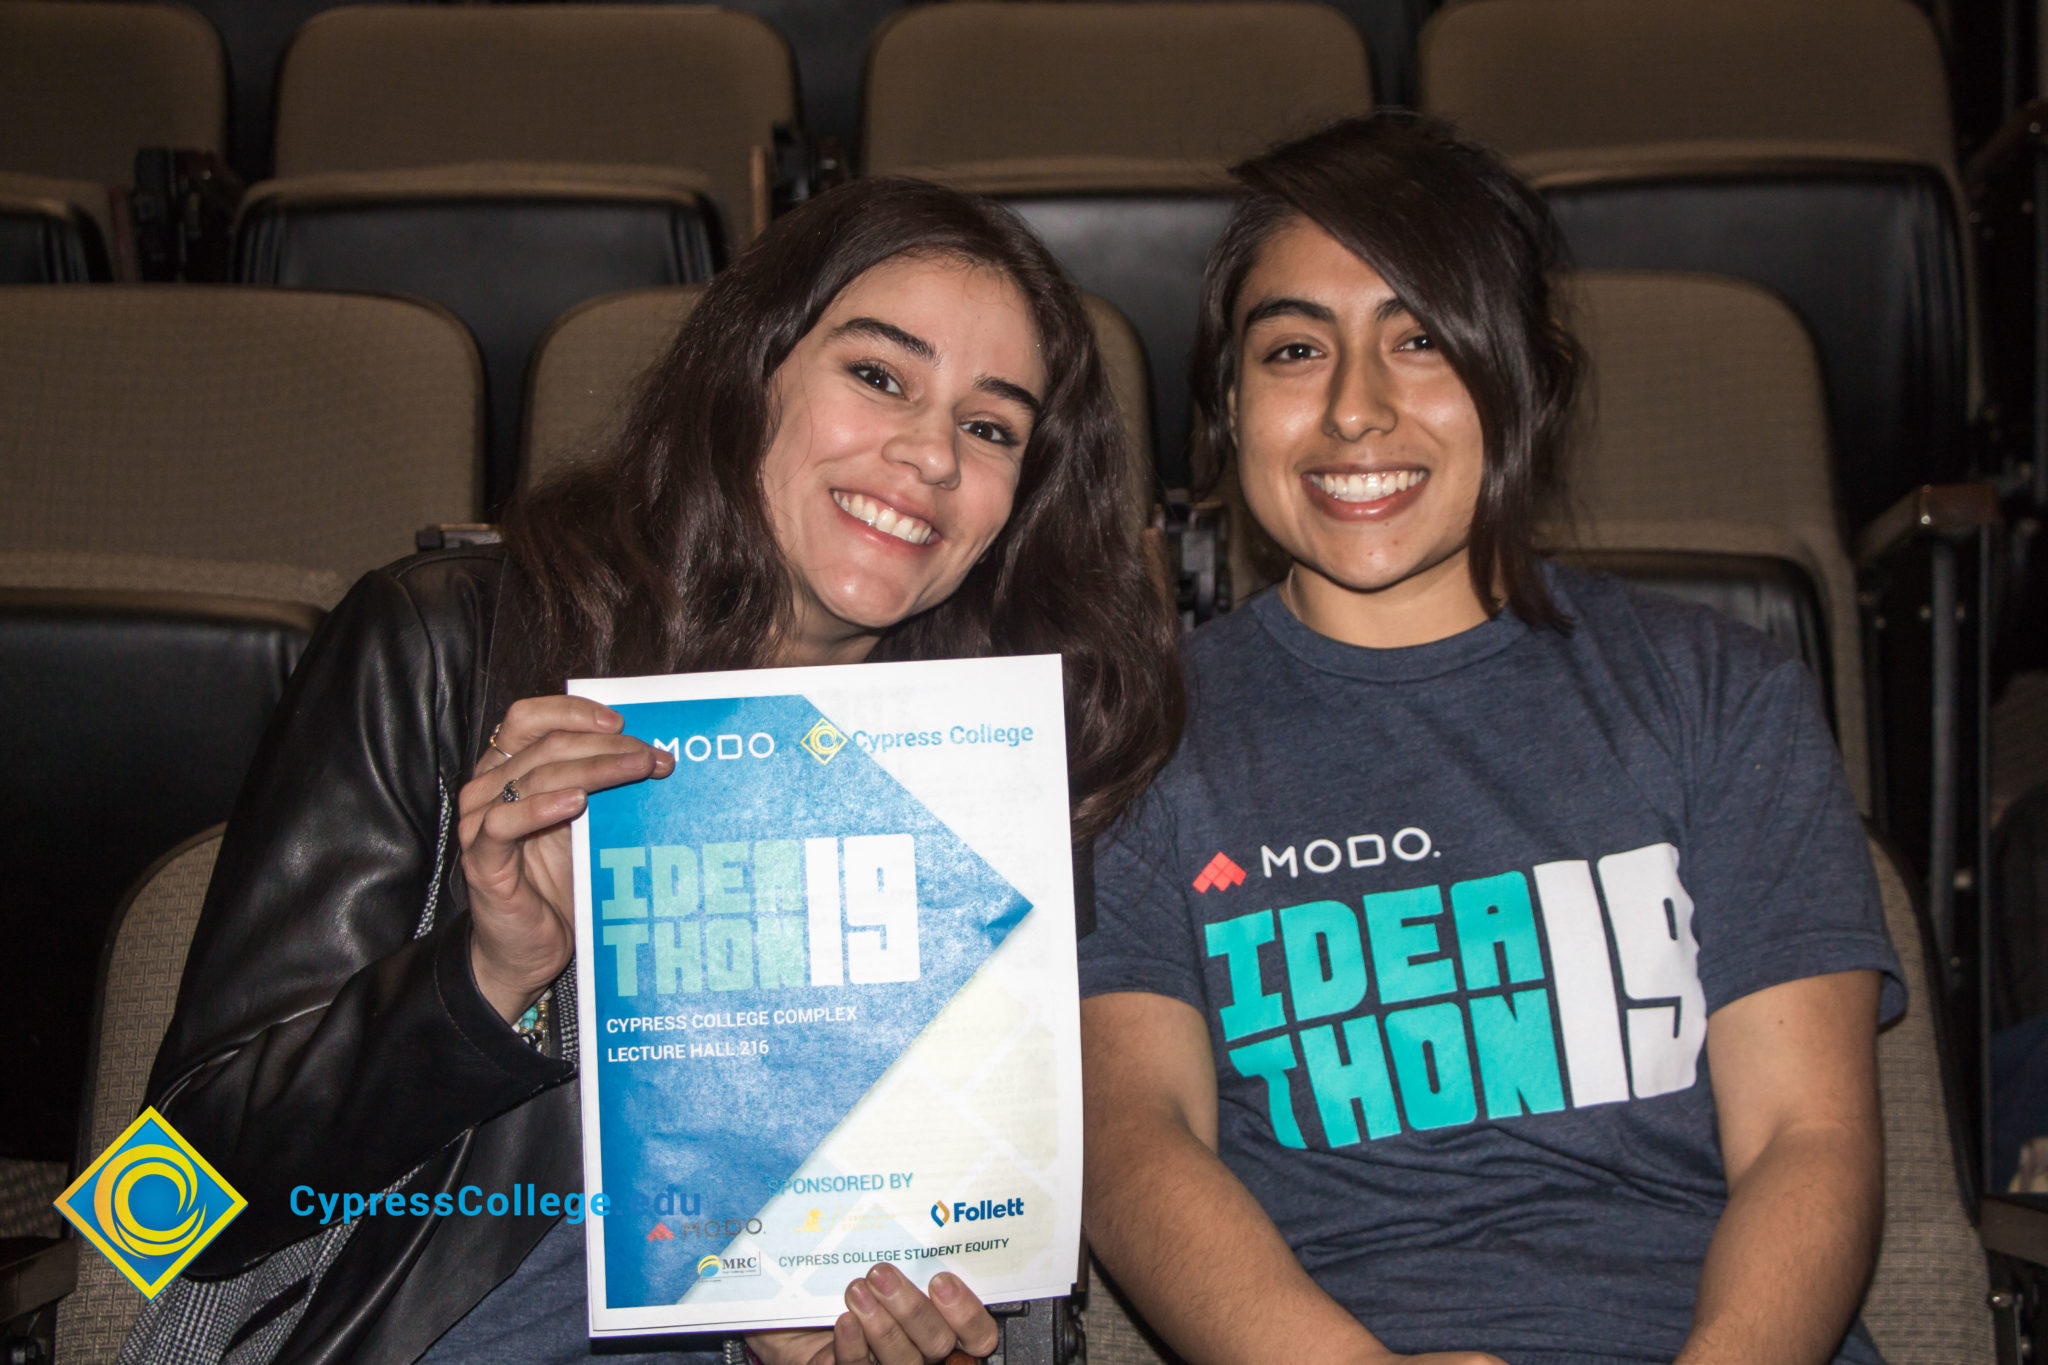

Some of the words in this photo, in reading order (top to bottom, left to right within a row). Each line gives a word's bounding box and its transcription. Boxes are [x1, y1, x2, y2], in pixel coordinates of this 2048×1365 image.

[853, 730, 943, 754] Cypress
[950, 724, 1034, 747] College
[600, 839, 803, 920] IDEA
[804, 833, 921, 987] 19
[602, 915, 805, 997] THON
[1204, 870, 1545, 1042] IDEA
[1533, 842, 1707, 1108] 19
[606, 1015, 687, 1033] CYPRESS
[692, 1011, 769, 1028] COLLEGE
[773, 1006, 858, 1025] COMPLEX
[607, 1044, 685, 1062] LECTURE
[690, 1041, 734, 1058] HALL
[739, 1040, 769, 1056] 216
[1228, 988, 1565, 1149] THON
[767, 1174, 884, 1196] SPONSORED
[890, 1172, 914, 1188] BY
[953, 1197, 1025, 1223] Follett
[722, 1256, 758, 1270] MRC
[778, 1253, 839, 1268] CYPRESS
[843, 1250, 900, 1264] COLLEGE
[904, 1244, 962, 1260] STUDENT
[965, 1238, 1009, 1253] EQUITY
